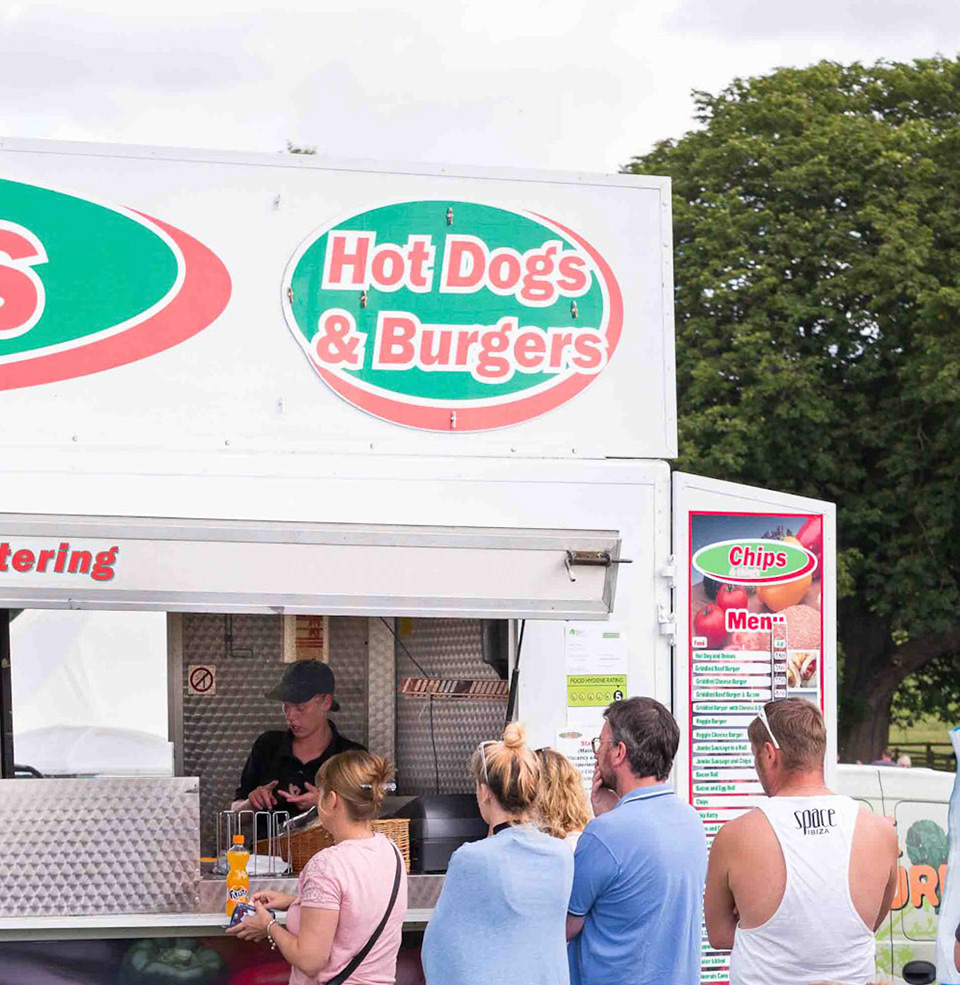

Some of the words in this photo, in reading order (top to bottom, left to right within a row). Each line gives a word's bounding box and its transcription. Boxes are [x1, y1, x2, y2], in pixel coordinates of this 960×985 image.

[326, 234, 433, 289] Hot
[444, 238, 589, 303] Dogs
[315, 312, 364, 367] &
[376, 314, 604, 380] Burgers
[728, 546, 788, 571] Chips
[793, 808, 838, 836] space
